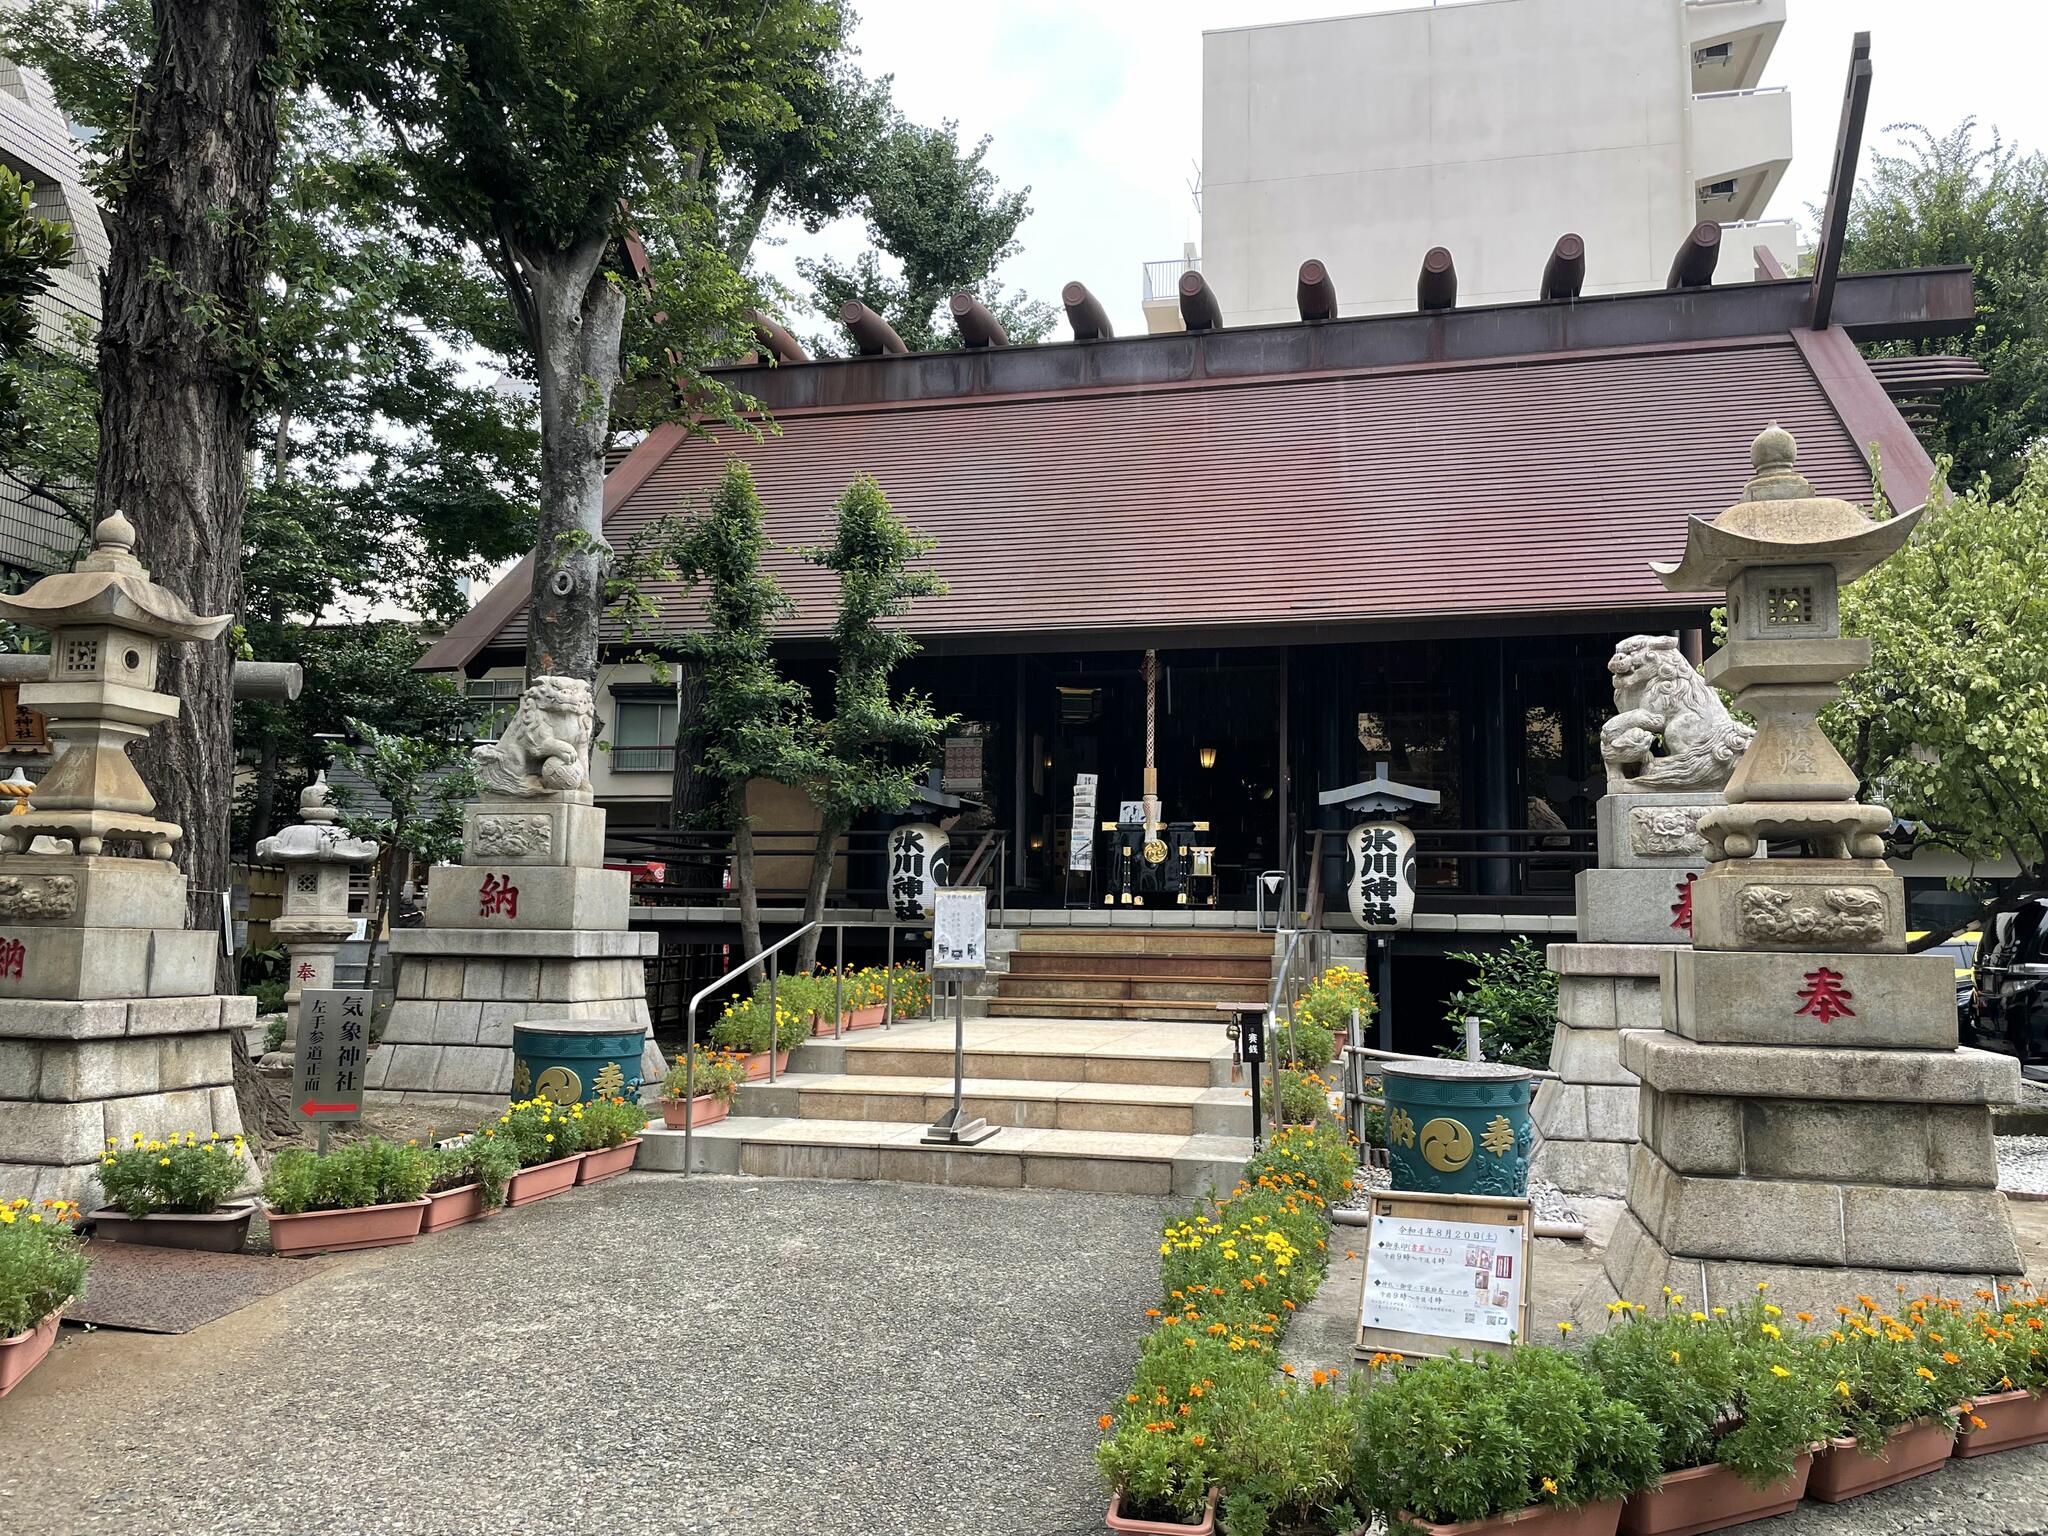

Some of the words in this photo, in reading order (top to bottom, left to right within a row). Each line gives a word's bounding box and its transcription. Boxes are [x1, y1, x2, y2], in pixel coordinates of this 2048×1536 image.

[478, 872, 520, 920] 納
[892, 829, 926, 922] 氷川神社
[1360, 828, 1398, 926] 氷川神社
[296, 962, 316, 982] 奉
[1793, 966, 1857, 1025] 奉
[303, 998, 328, 1093] 左手参道正面
[335, 995, 365, 1093] 気象神社
[591, 1061, 625, 1099] 奉
[1389, 1106, 1417, 1149] 納
[1479, 1114, 1516, 1158] 奉
